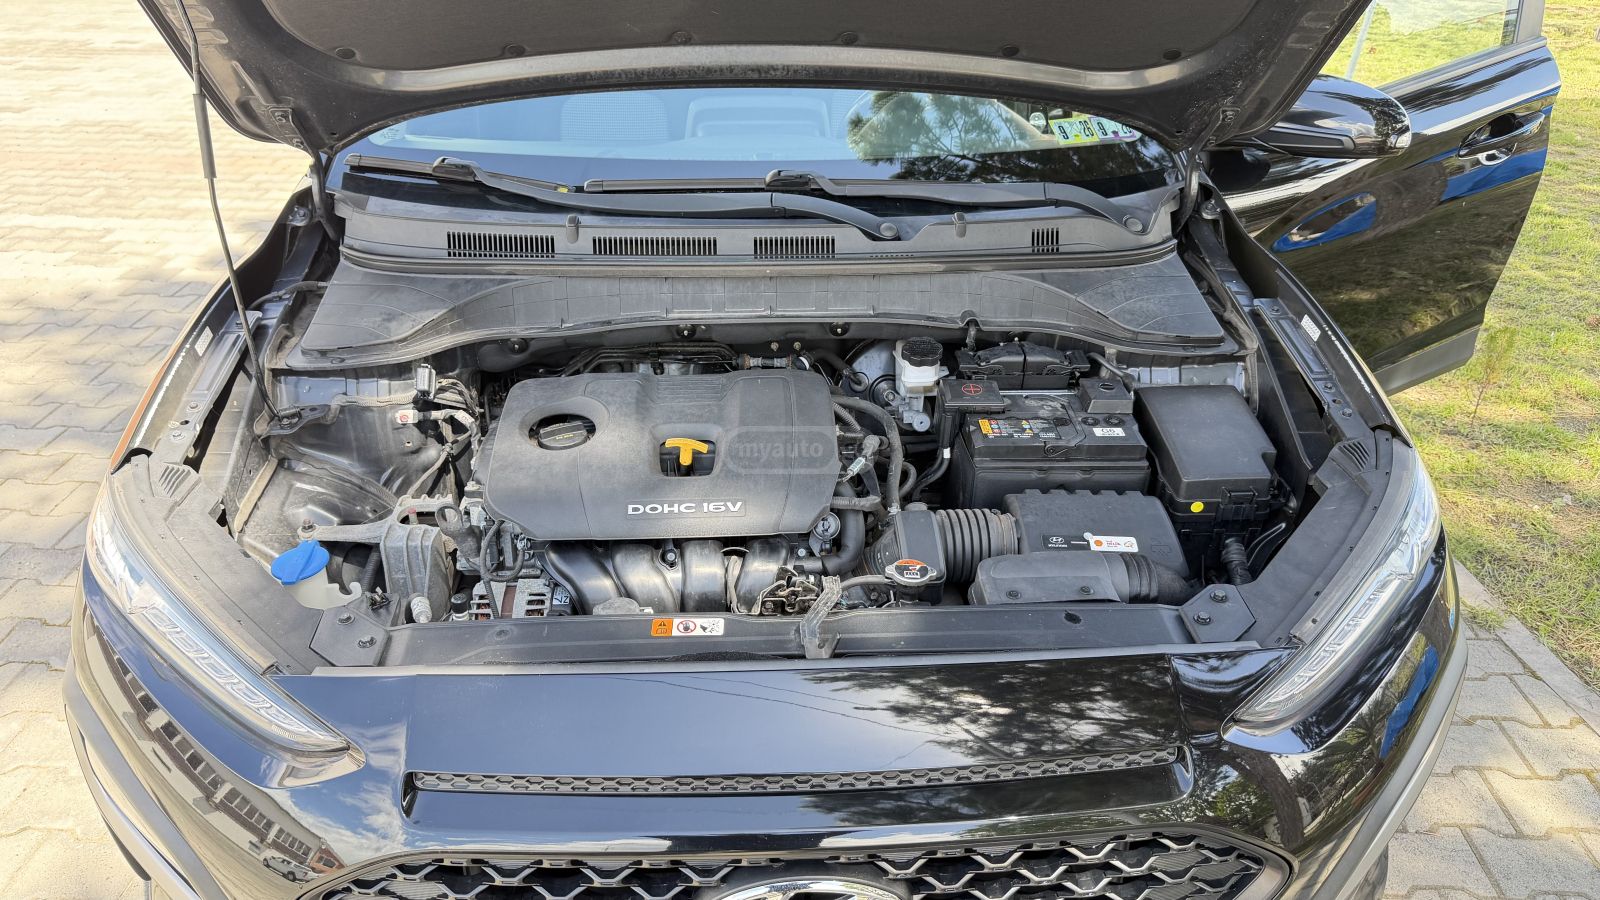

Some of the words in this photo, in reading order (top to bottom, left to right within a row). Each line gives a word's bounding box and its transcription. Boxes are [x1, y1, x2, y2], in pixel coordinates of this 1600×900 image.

[1058, 125, 1069, 140] 9
[1079, 120, 1094, 137] 26
[1096, 121, 1108, 136] 9
[627, 503, 696, 515] DOHC
[703, 501, 743, 513] 16V
